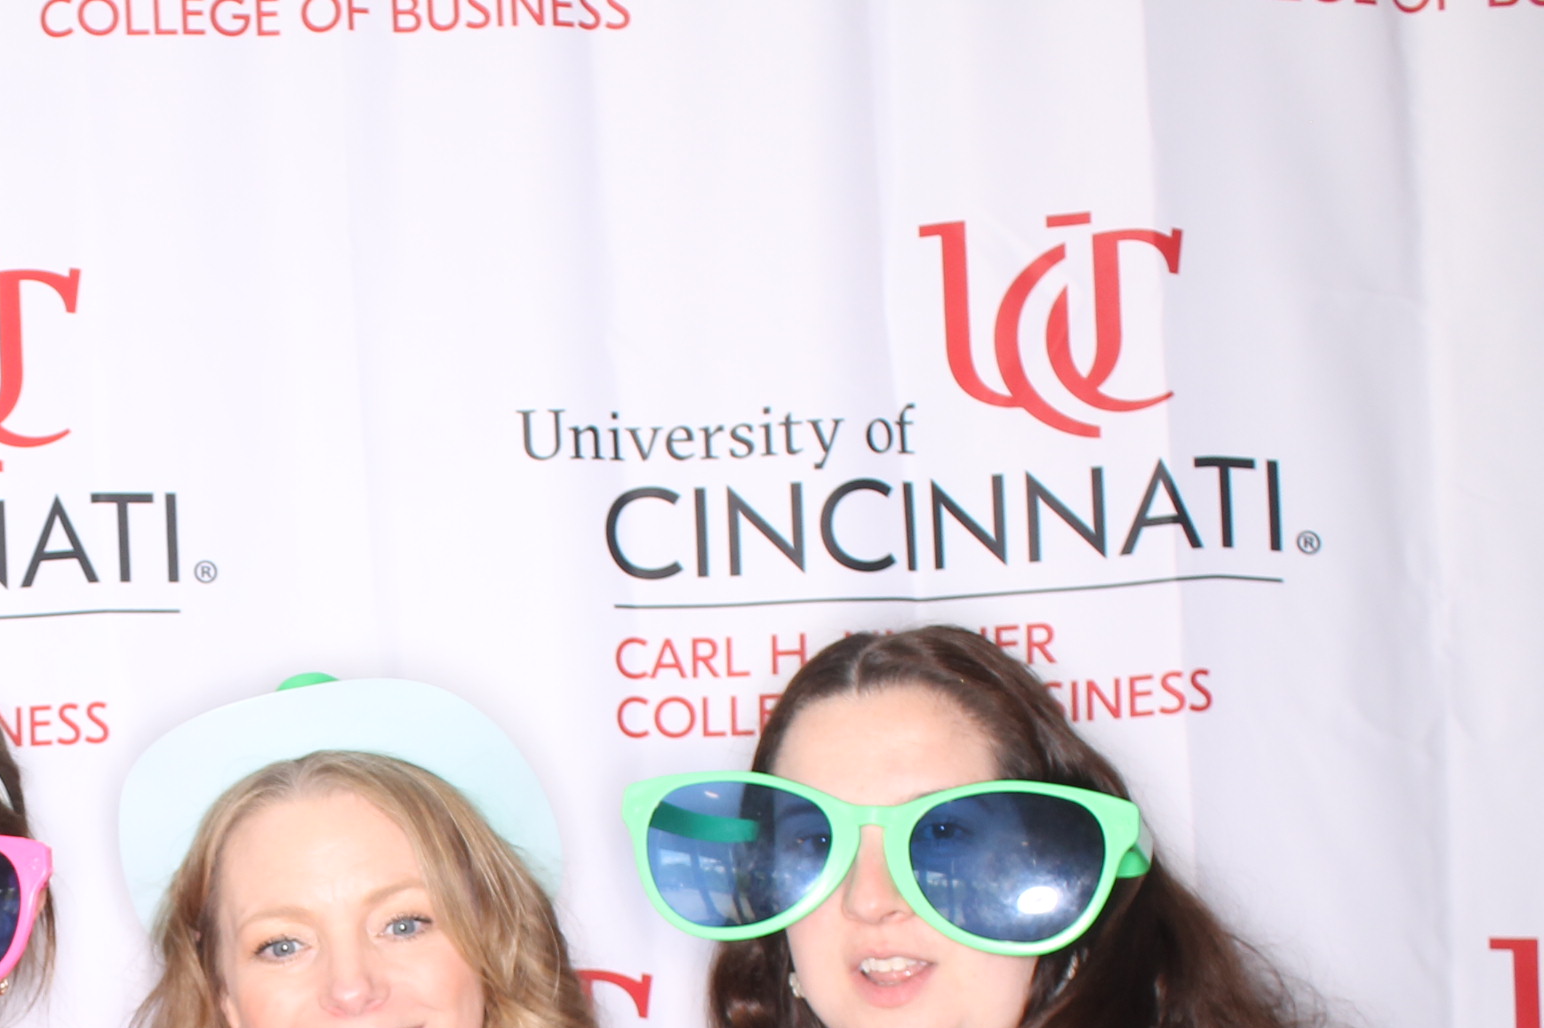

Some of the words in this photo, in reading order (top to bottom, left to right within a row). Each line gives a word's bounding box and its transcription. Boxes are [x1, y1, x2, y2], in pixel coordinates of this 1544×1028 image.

[40, 0, 280, 38] COLLEGE
[301, 0, 370, 33] OF
[391, 0, 631, 33] BUSINESS
[516, 404, 844, 471] University
[864, 403, 916, 456] of
[615, 636, 751, 680] CARL
